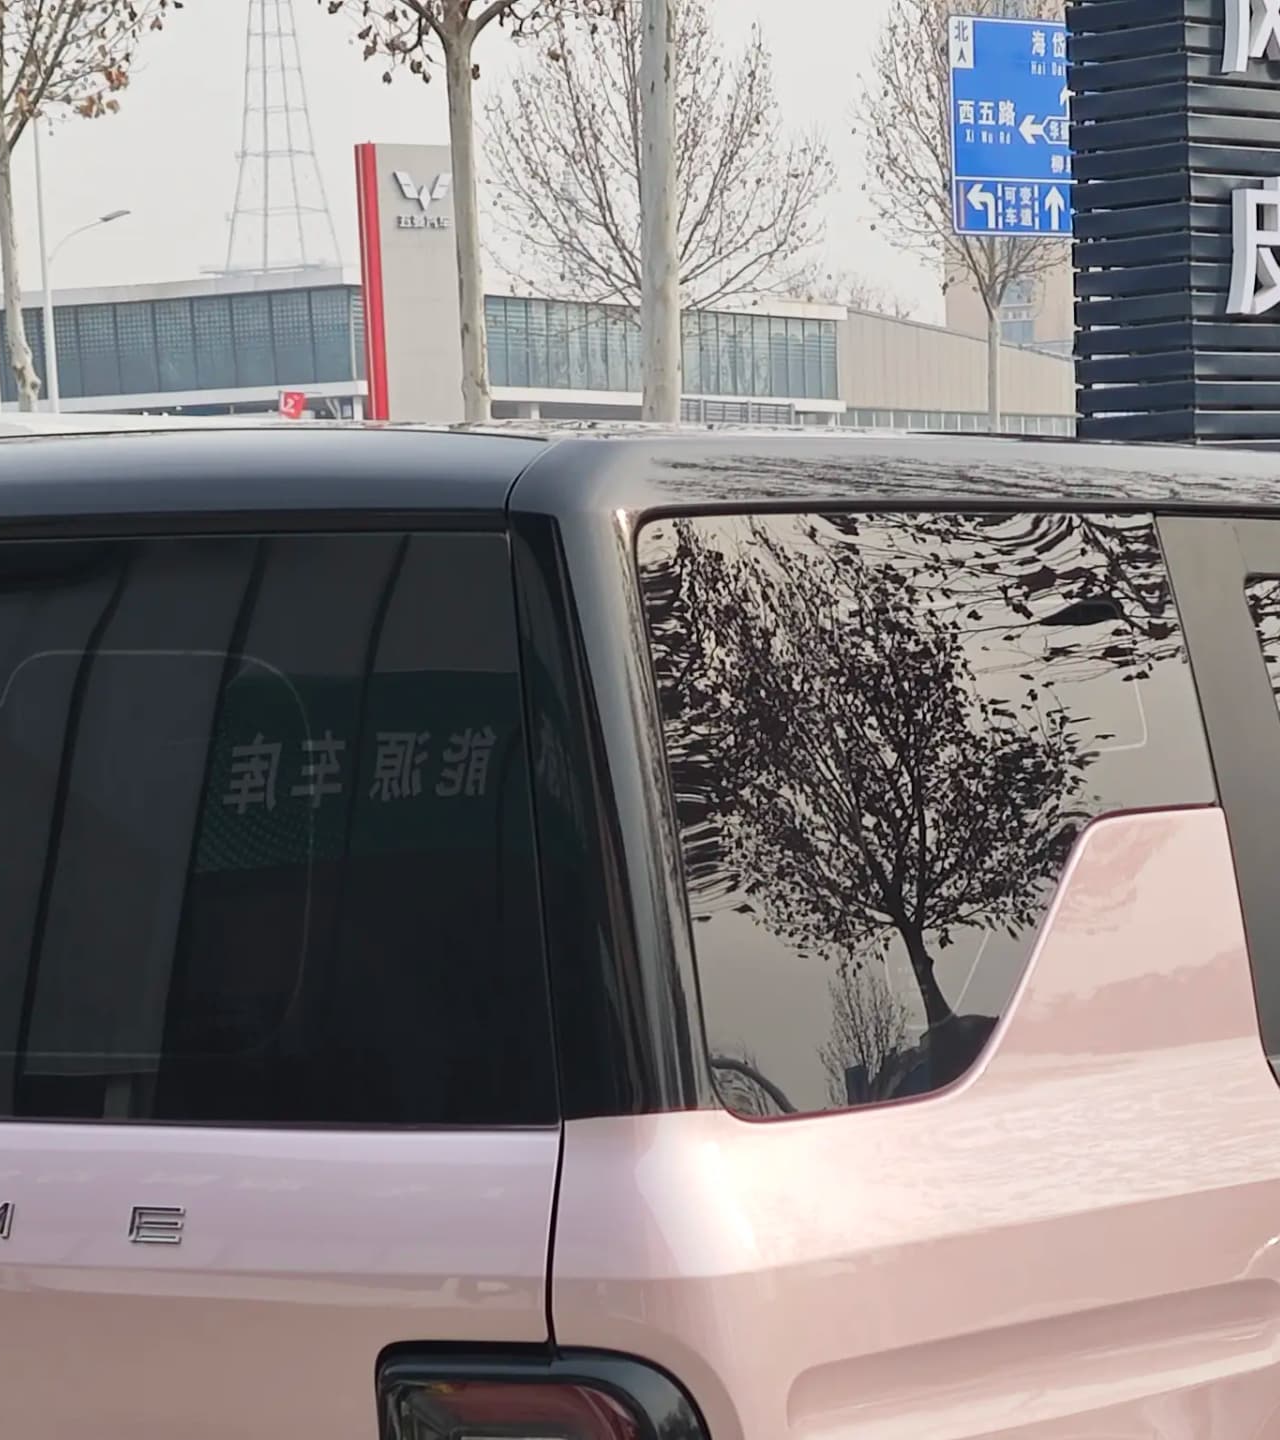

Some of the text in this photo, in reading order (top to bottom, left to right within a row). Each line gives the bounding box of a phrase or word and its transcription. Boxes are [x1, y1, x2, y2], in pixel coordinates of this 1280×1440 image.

[954, 20, 969, 42] 北
[957, 99, 1016, 126] 西五路
